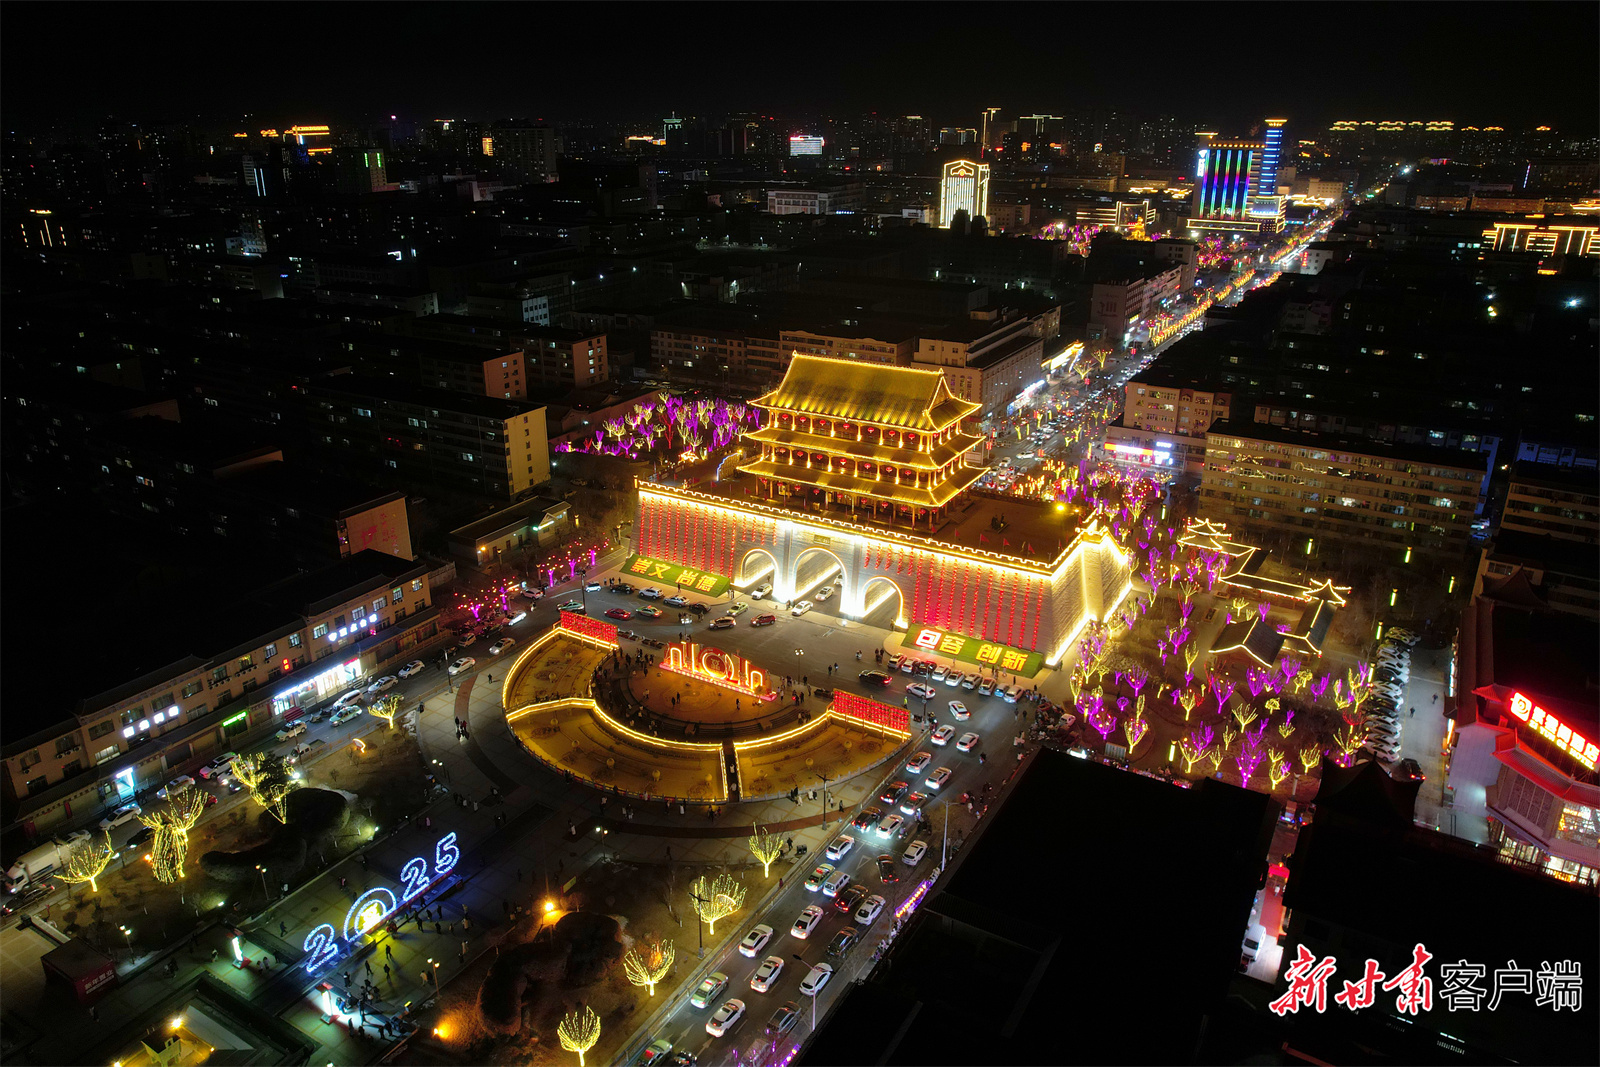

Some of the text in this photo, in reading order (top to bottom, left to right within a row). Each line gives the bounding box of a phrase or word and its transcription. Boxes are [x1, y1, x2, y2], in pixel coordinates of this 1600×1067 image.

[630, 557, 718, 592] 崇文 尚德
[975, 643, 1029, 672] 创新
[1569, 747, 1595, 770] HOTEL
